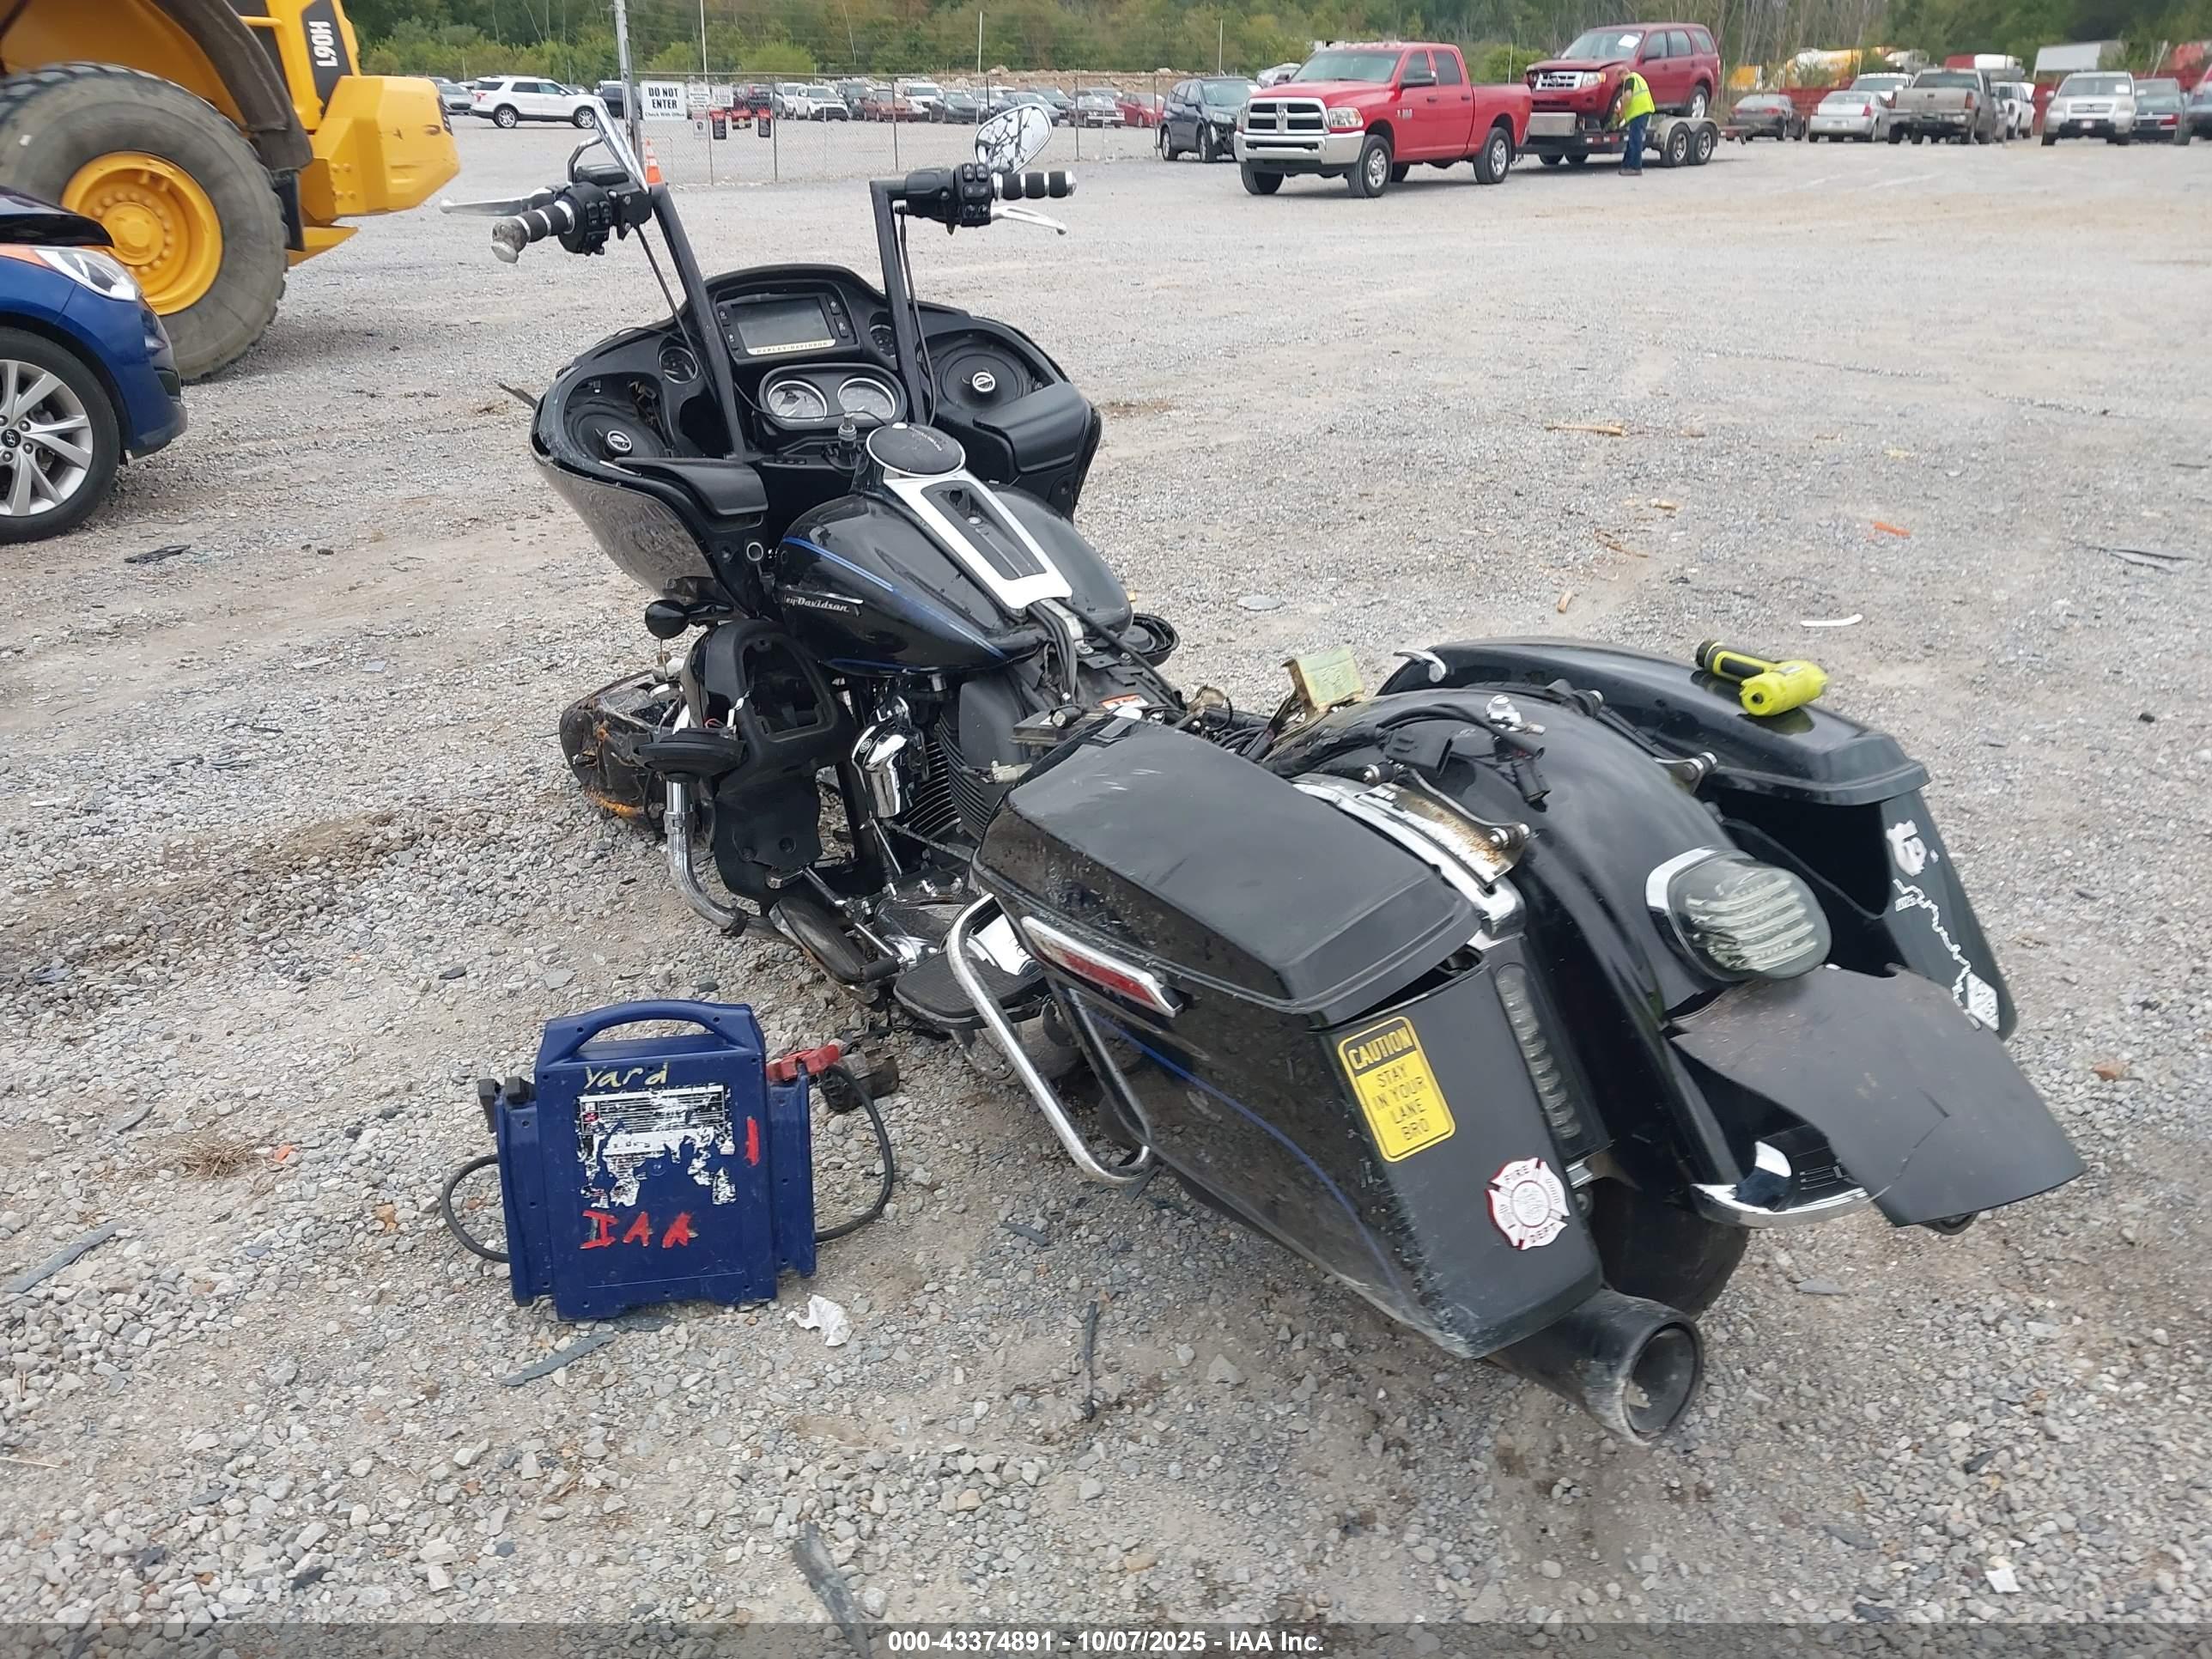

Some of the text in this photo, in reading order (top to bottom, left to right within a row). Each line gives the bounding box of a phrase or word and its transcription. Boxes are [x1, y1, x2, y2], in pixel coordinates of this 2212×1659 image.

[308, 21, 338, 67] L90H
[647, 87, 660, 97] DO
[662, 88, 678, 98] NOT
[652, 99, 678, 109] ENTER
[1347, 1026, 1414, 1070] CAUTION
[1376, 1062, 1408, 1088] STAY
[1372, 1075, 1428, 1111] IN YOUR
[1389, 1098, 1427, 1124] LANE
[1401, 1118, 1431, 1141] BRO
